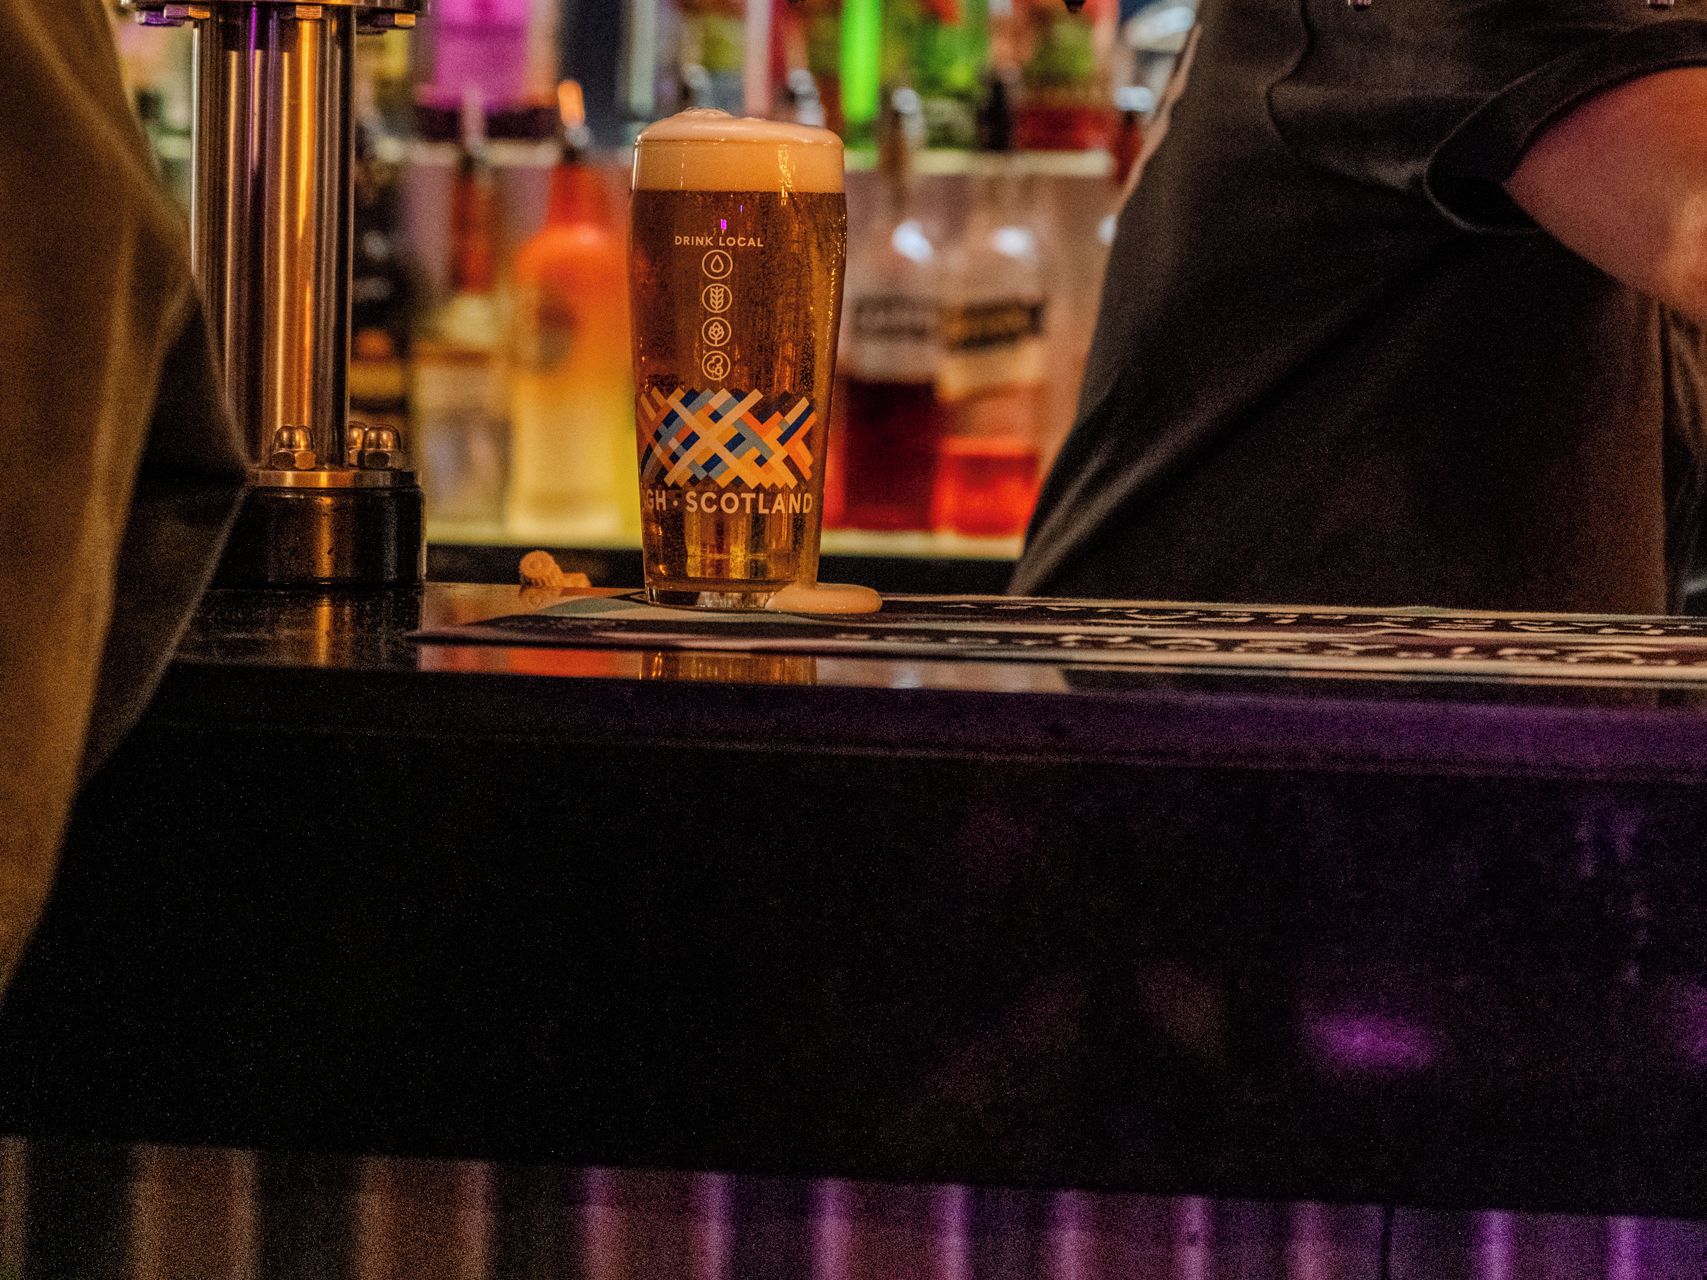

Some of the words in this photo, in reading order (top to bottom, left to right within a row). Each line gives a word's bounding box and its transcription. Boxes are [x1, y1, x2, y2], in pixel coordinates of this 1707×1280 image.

[674, 235, 714, 246] DRINK
[719, 236, 764, 247] LOCAL
[685, 491, 813, 514] SCOTLAND
